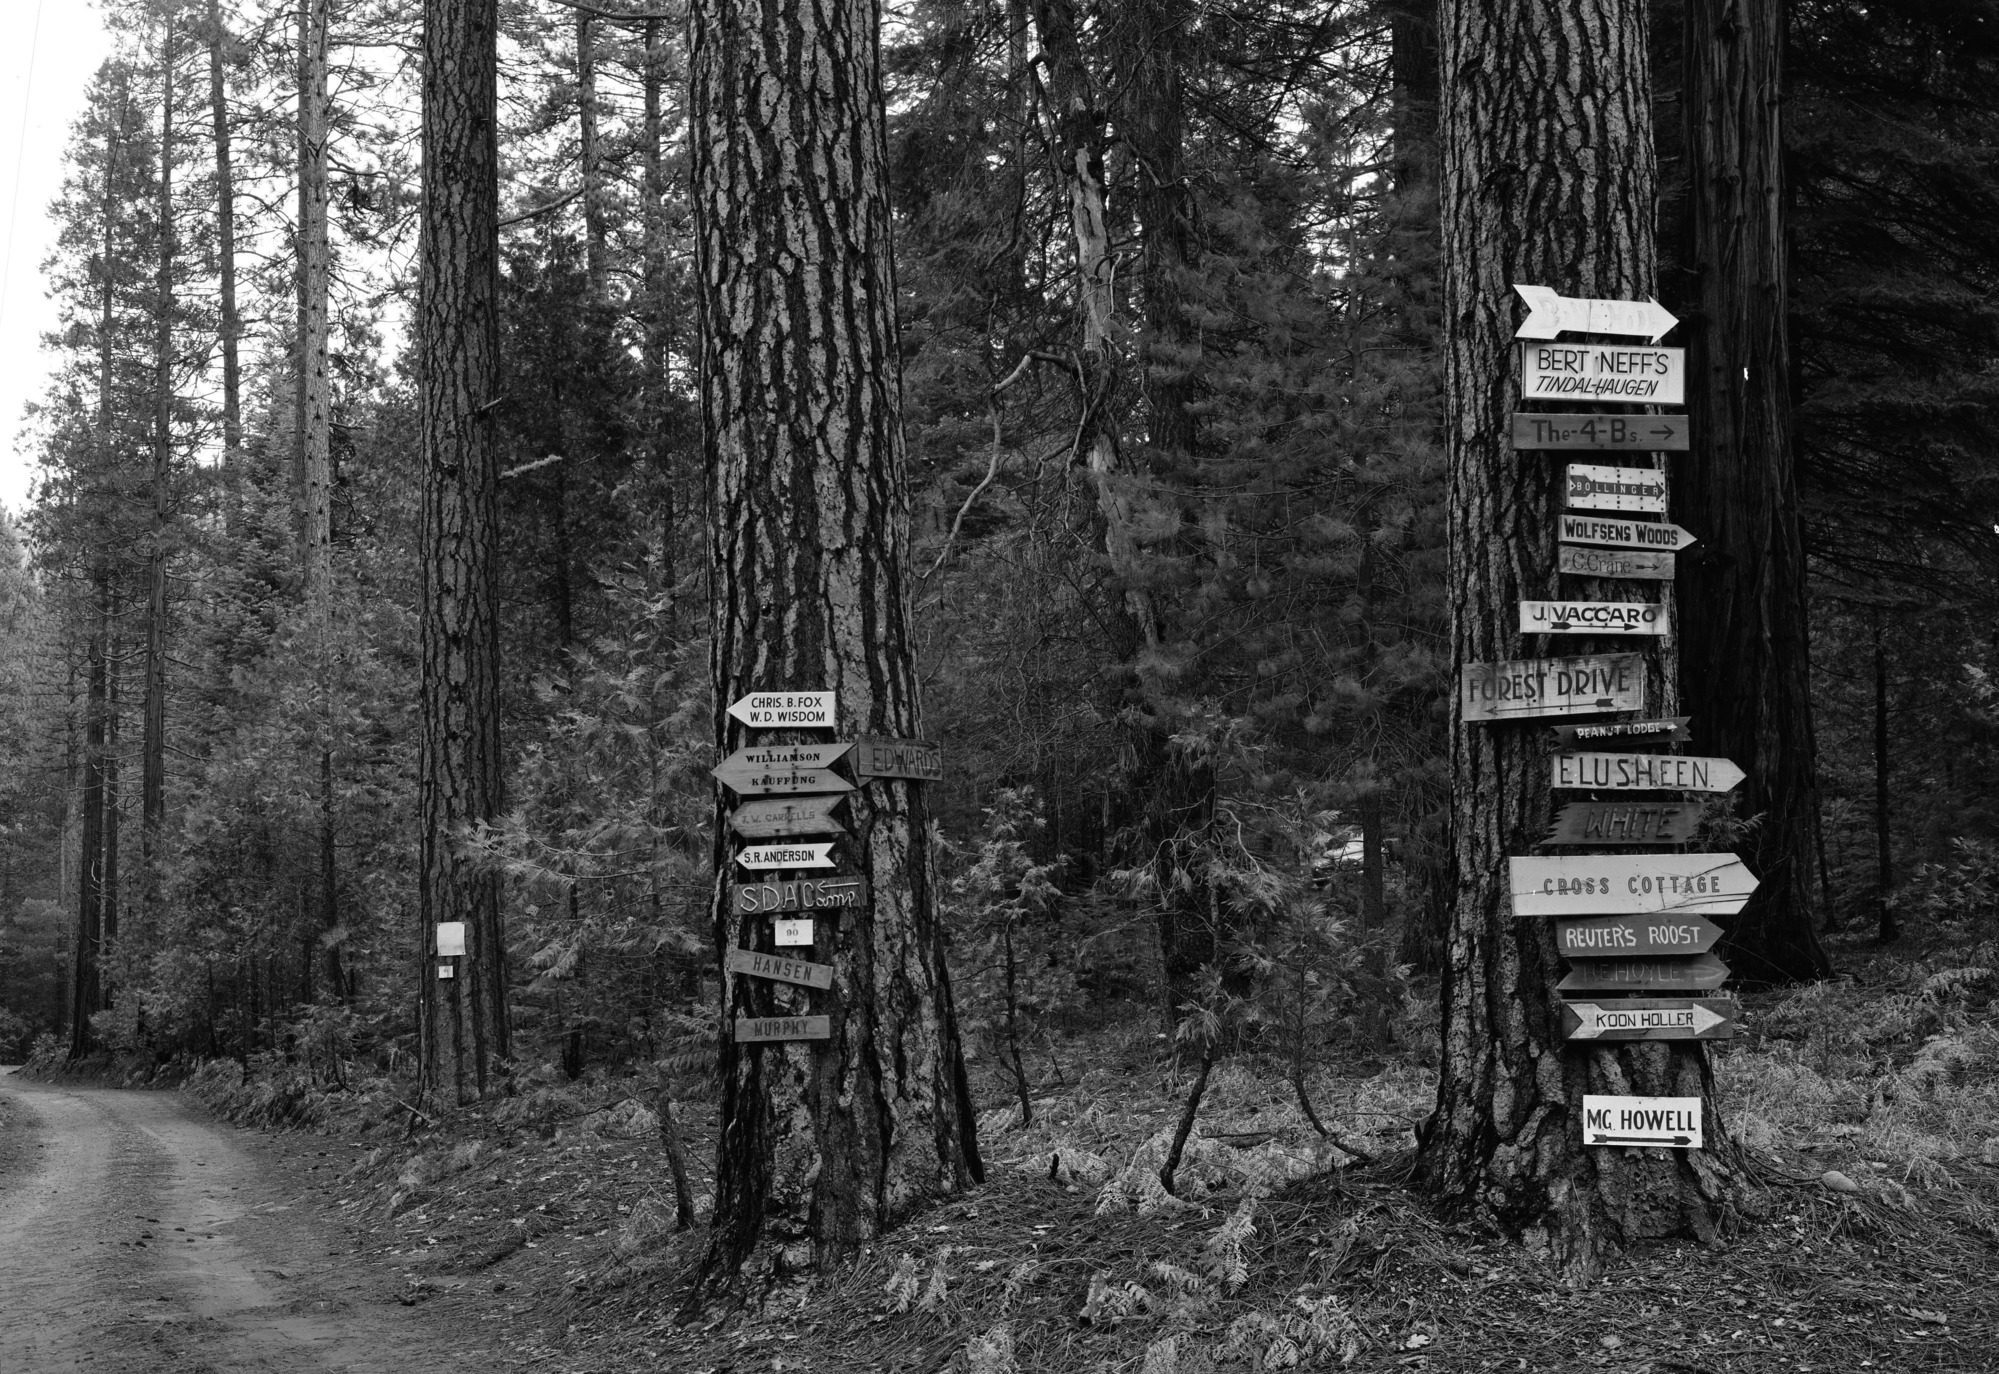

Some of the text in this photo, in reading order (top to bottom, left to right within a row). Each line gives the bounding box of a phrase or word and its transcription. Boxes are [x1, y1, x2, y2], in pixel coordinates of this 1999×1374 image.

[1538, 349, 1669, 375] BERT NEFF'S
[1536, 375, 1659, 396] TINDAL-HAUGEN
[1576, 481, 1659, 496] BOLLINGER
[1563, 518, 1678, 546] WOLFSENS WOODS
[1552, 606, 1657, 623] VACCARO
[1469, 666, 1631, 702] FOREST DRIVE
[777, 711, 825, 722] WISDOM
[1577, 722, 1661, 739] PEANUT LODGE
[745, 752, 821, 763] WILLIAMSON
[872, 748, 941, 777] EDWARDS
[765, 810, 815, 823] CARRELLS
[1584, 806, 1680, 840] WHITE
[1543, 876, 1720, 895] CROSS COTTAGE
[741, 882, 855, 911] SDA Camp
[786, 928, 799, 937] 90
[1566, 924, 1700, 948] REUTER'S ROOST
[753, 956, 813, 981] HANSEN
[754, 1019, 808, 1037] MURPHY
[1596, 1012, 1694, 1028] KOON HOLLER
[1620, 1109, 1696, 1132] HOWELL
